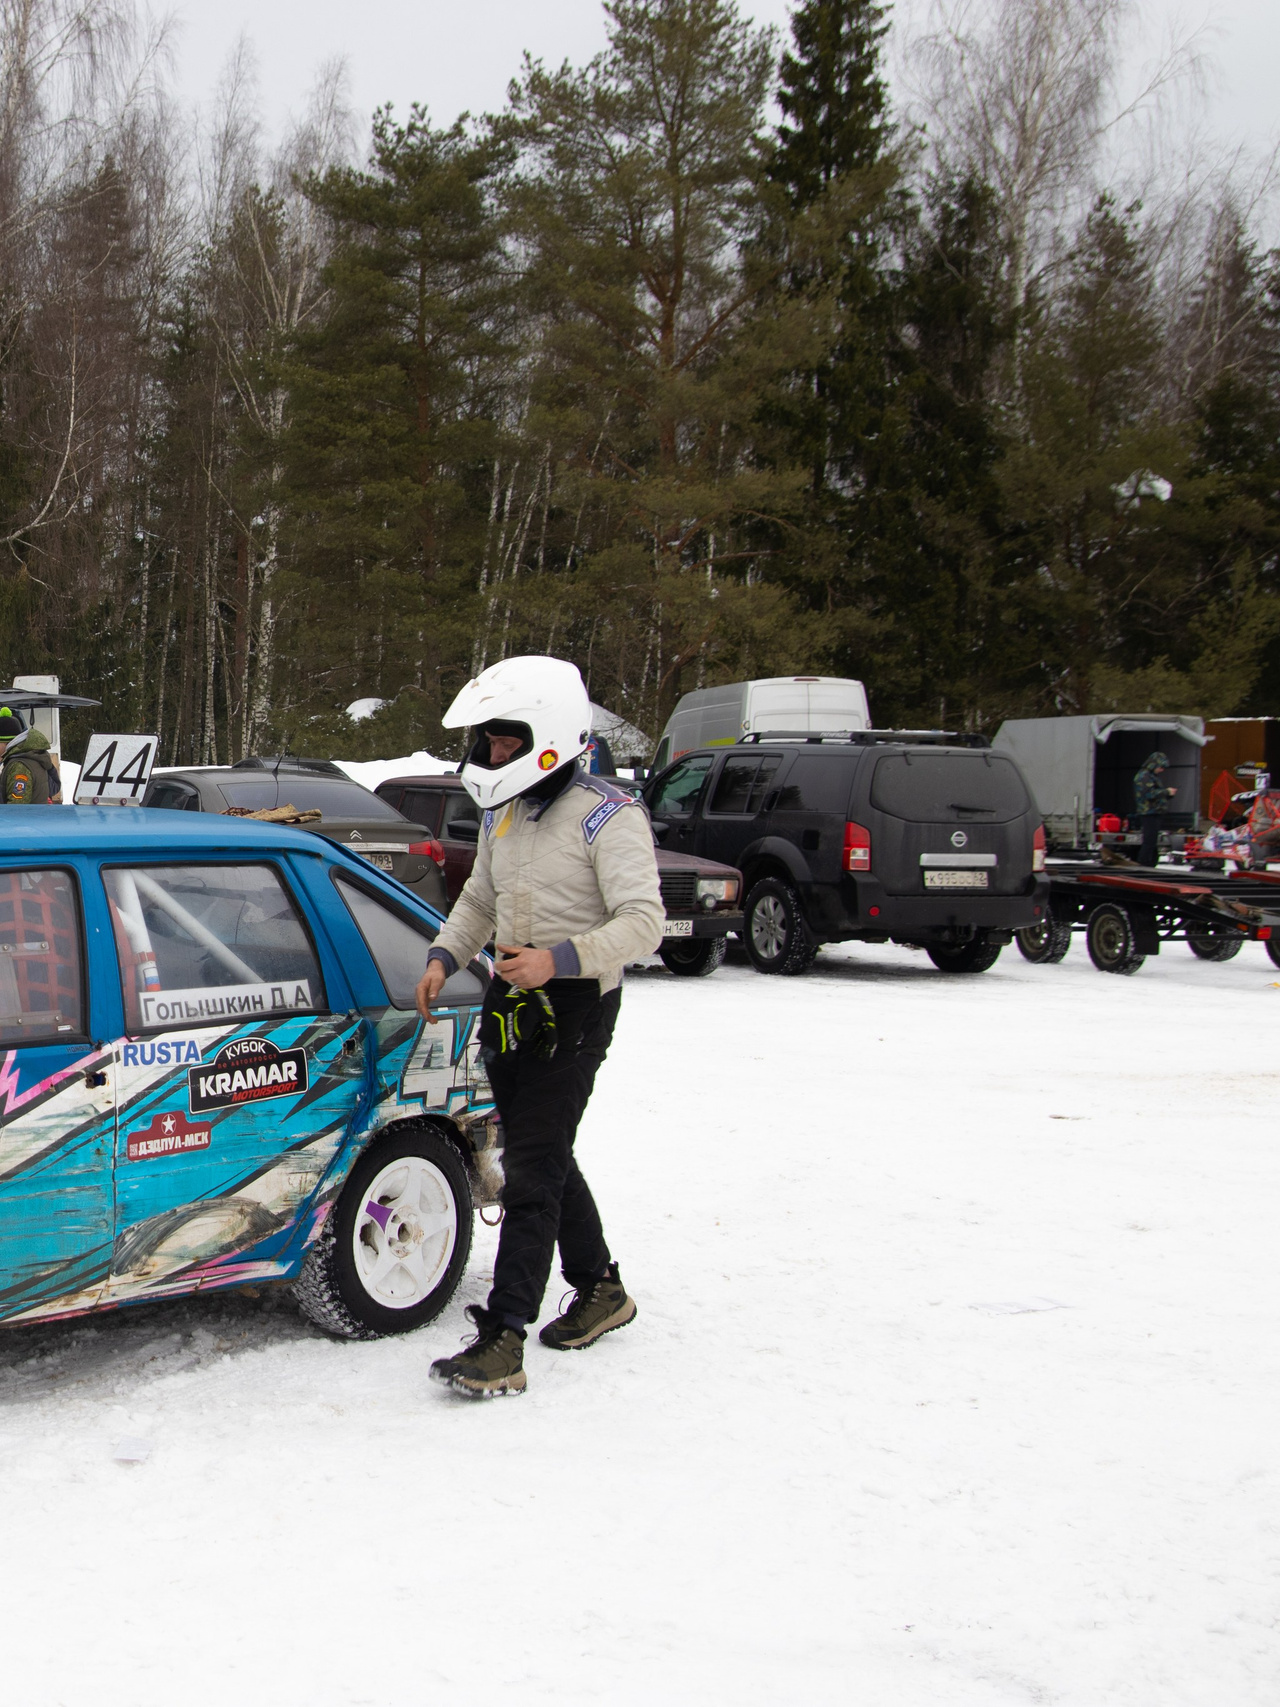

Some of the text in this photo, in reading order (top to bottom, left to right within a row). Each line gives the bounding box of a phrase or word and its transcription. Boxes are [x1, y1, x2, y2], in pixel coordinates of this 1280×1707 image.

[82, 740, 152, 798] 44
[587, 801, 617, 830] sparco
[674, 922, 690, 931] 122
[142, 995, 264, 1022] Голышкин
[123, 1040, 200, 1067] RUSTA
[225, 1040, 267, 1060] КУБОК
[199, 1060, 298, 1098] KRAMAR
[231, 1081, 298, 1102] MOTORSPORT
